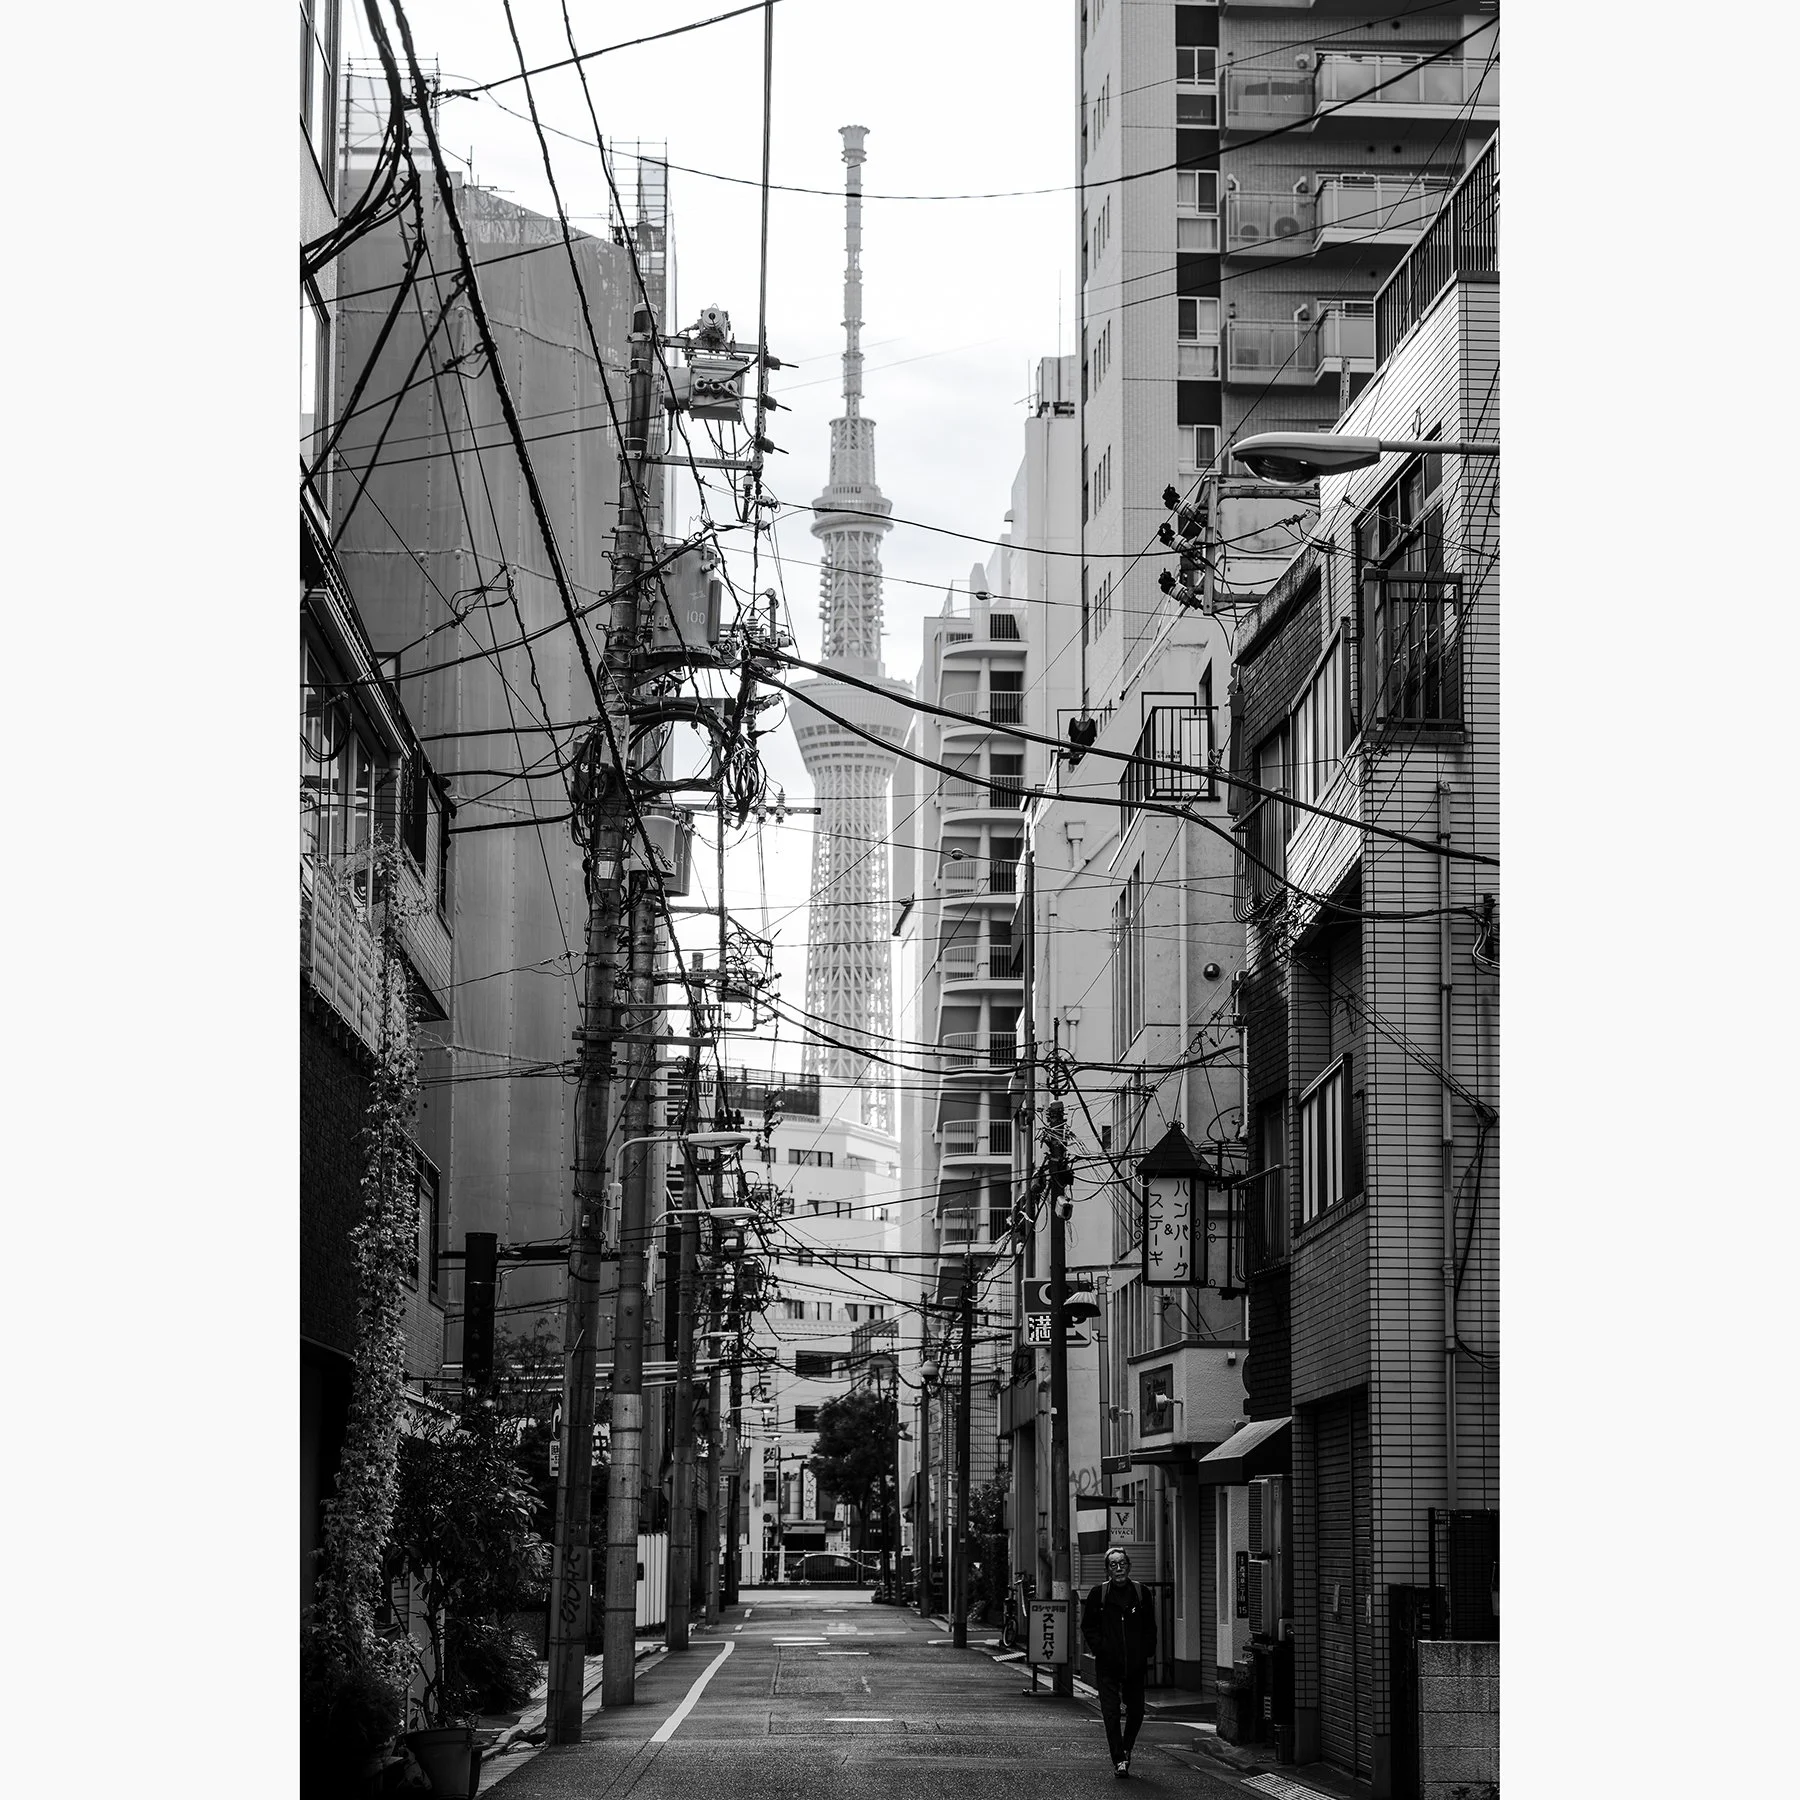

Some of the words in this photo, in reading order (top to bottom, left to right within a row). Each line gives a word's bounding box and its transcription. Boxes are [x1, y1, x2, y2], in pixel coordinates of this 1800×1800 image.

[686, 610, 706, 625] 100
[1149, 1192, 1164, 1267] ステーキ
[1163, 1223, 1173, 1236] &
[1173, 1180, 1189, 1279] ハンバーグ
[1238, 1606, 1247, 1614] 15
[1042, 1613, 1055, 1660] ストロバヤ
